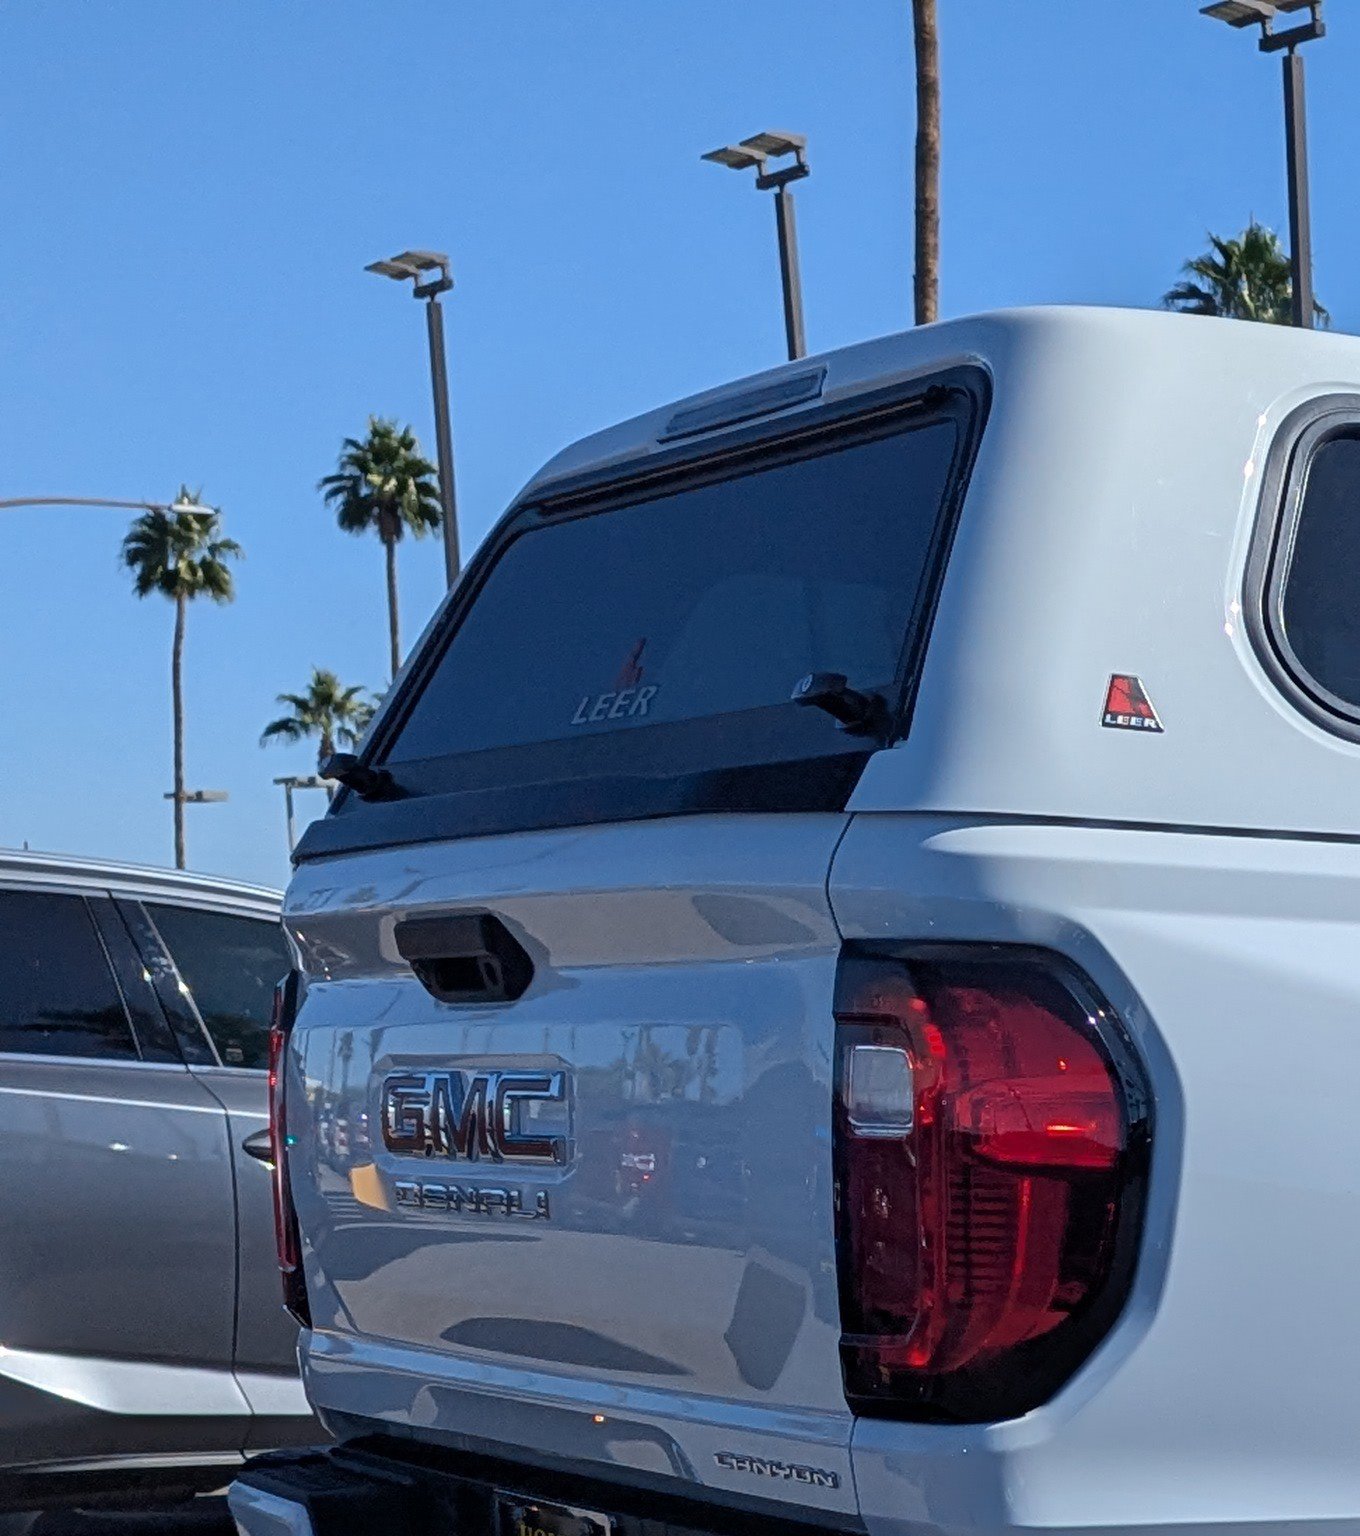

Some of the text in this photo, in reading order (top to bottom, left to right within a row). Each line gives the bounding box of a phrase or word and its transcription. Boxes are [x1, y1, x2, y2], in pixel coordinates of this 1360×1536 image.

[572, 685, 658, 725] LEER
[1104, 713, 1158, 728] LEER
[382, 1070, 567, 1166] GMC
[395, 1181, 550, 1219] DENALI
[713, 1451, 840, 1488] CANYON
